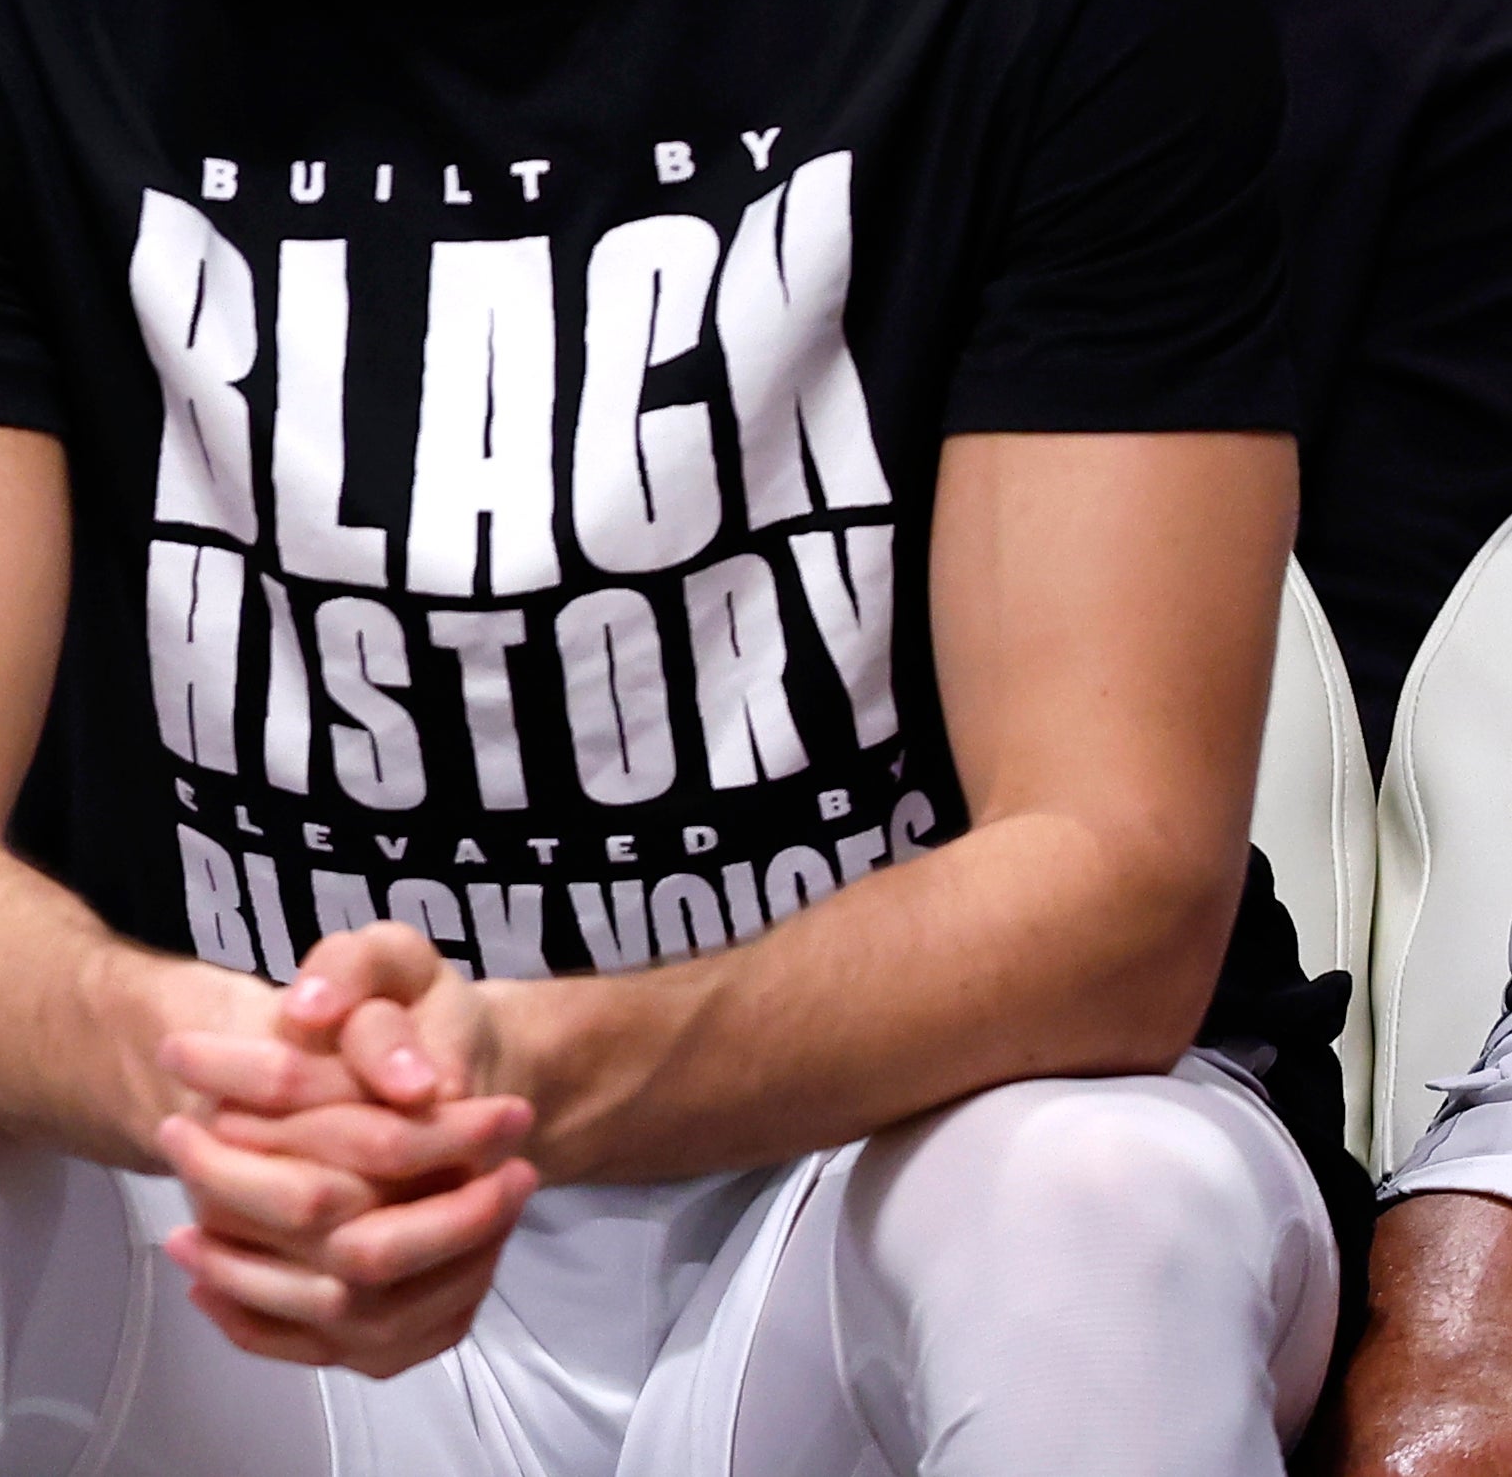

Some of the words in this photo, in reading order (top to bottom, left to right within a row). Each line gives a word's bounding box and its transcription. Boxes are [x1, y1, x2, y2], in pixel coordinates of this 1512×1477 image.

[201, 157, 551, 204] BUILT
[654, 126, 781, 184] BY
[129, 149, 892, 598] BLACK
[146, 524, 898, 811] HISTORY
[175, 777, 719, 865] ELEVATED
